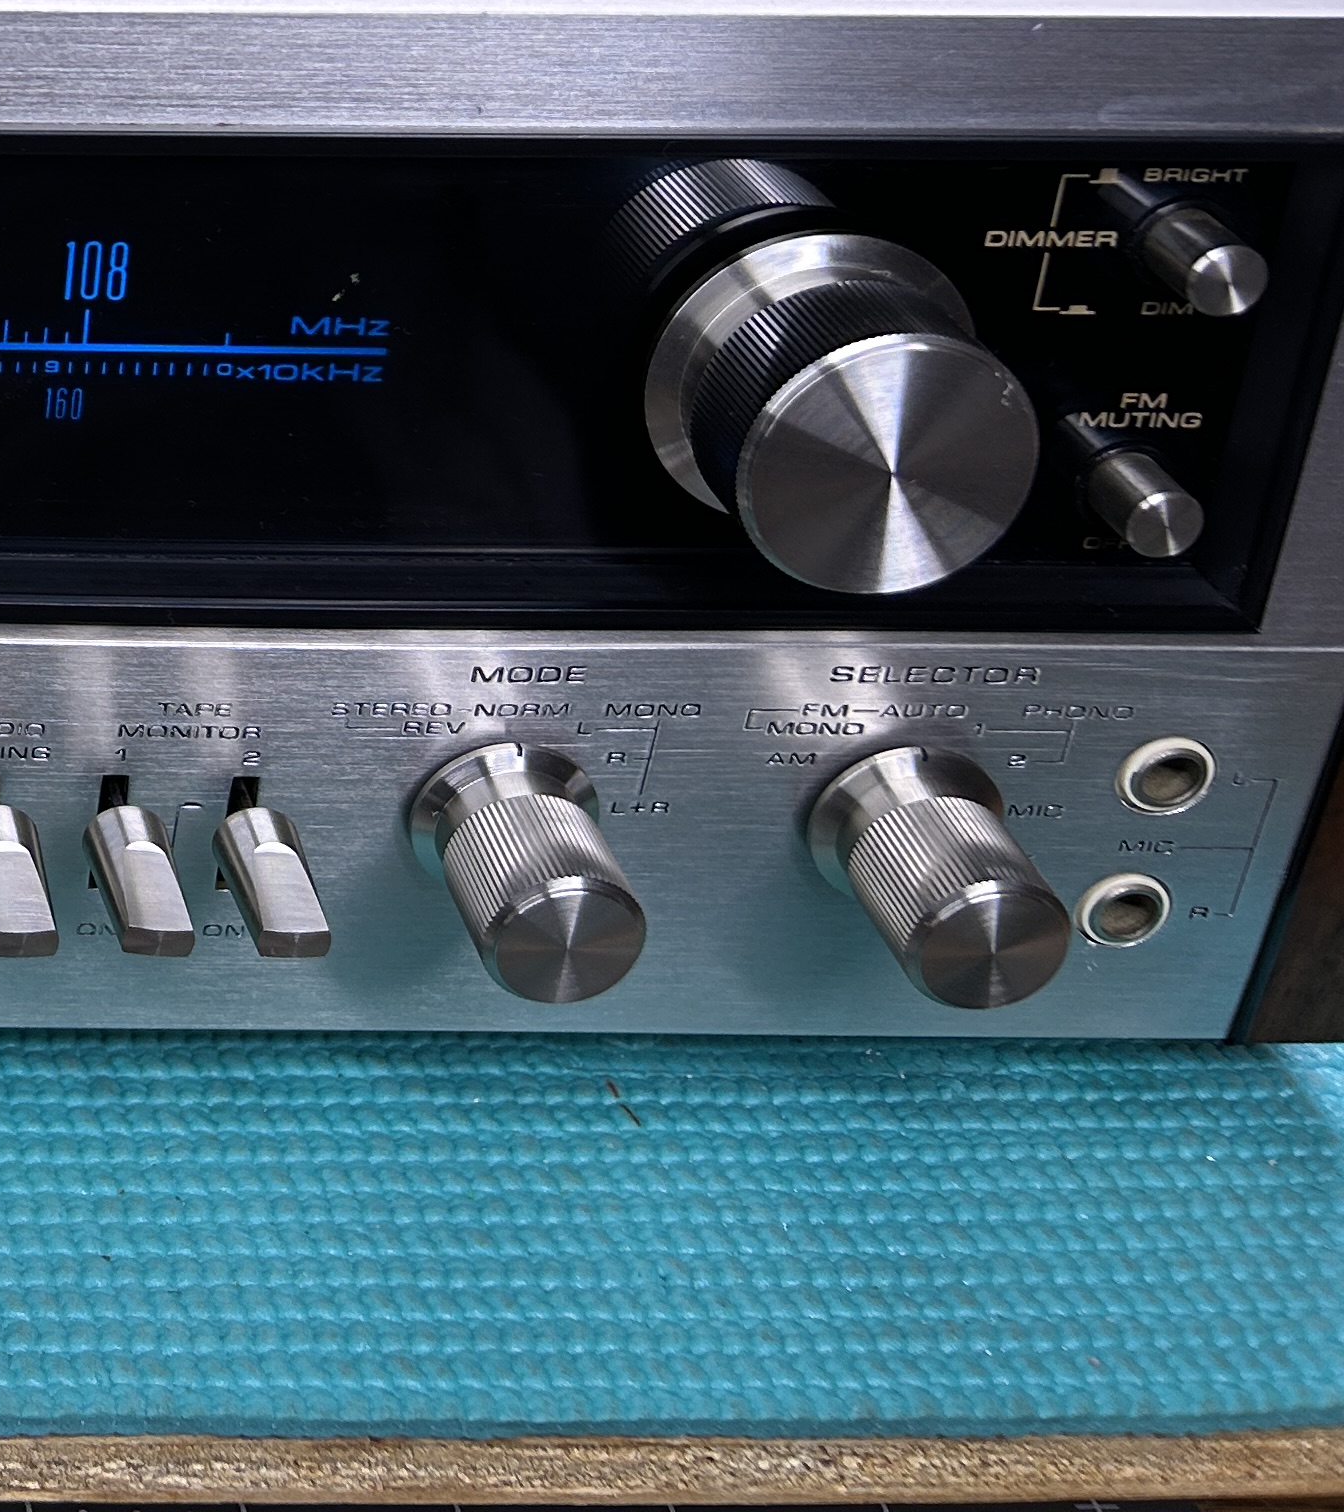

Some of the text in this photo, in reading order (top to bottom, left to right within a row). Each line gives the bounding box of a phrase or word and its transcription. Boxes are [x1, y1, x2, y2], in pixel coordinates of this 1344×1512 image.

[1142, 167, 1250, 184] BRIGHT
[983, 229, 1119, 249] DIMMER
[64, 240, 130, 302] 108
[1140, 300, 1196, 317] DIM
[290, 315, 390, 337] MHz
[44, 359, 60, 374] 9
[216, 362, 233, 377] 0
[45, 387, 84, 421] 160
[1119, 392, 1169, 409] FM
[1077, 411, 1204, 430] MUTING
[469, 665, 589, 684] MODE
[829, 665, 1042, 685] SELECTOR
[157, 701, 233, 718] TAPE
[331, 701, 573, 718] STEREO NORM
[605, 702, 703, 718] MONO
[801, 703, 970, 719] FM AUTO
[1021, 704, 1136, 720] PHONO
[117, 722, 262, 741] MONITOR
[401, 721, 467, 736] REV
[577, 721, 594, 736] L
[765, 721, 866, 738] MONO
[115, 748, 127, 762] 1
[241, 748, 263, 766] 2
[605, 751, 628, 766] R
[765, 752, 818, 767] AM
[611, 801, 671, 816] L+R
[1007, 803, 1065, 820] MIC
[1117, 839, 1176, 856] MIC
[1189, 906, 1210, 921] R
[202, 923, 246, 938] ON
